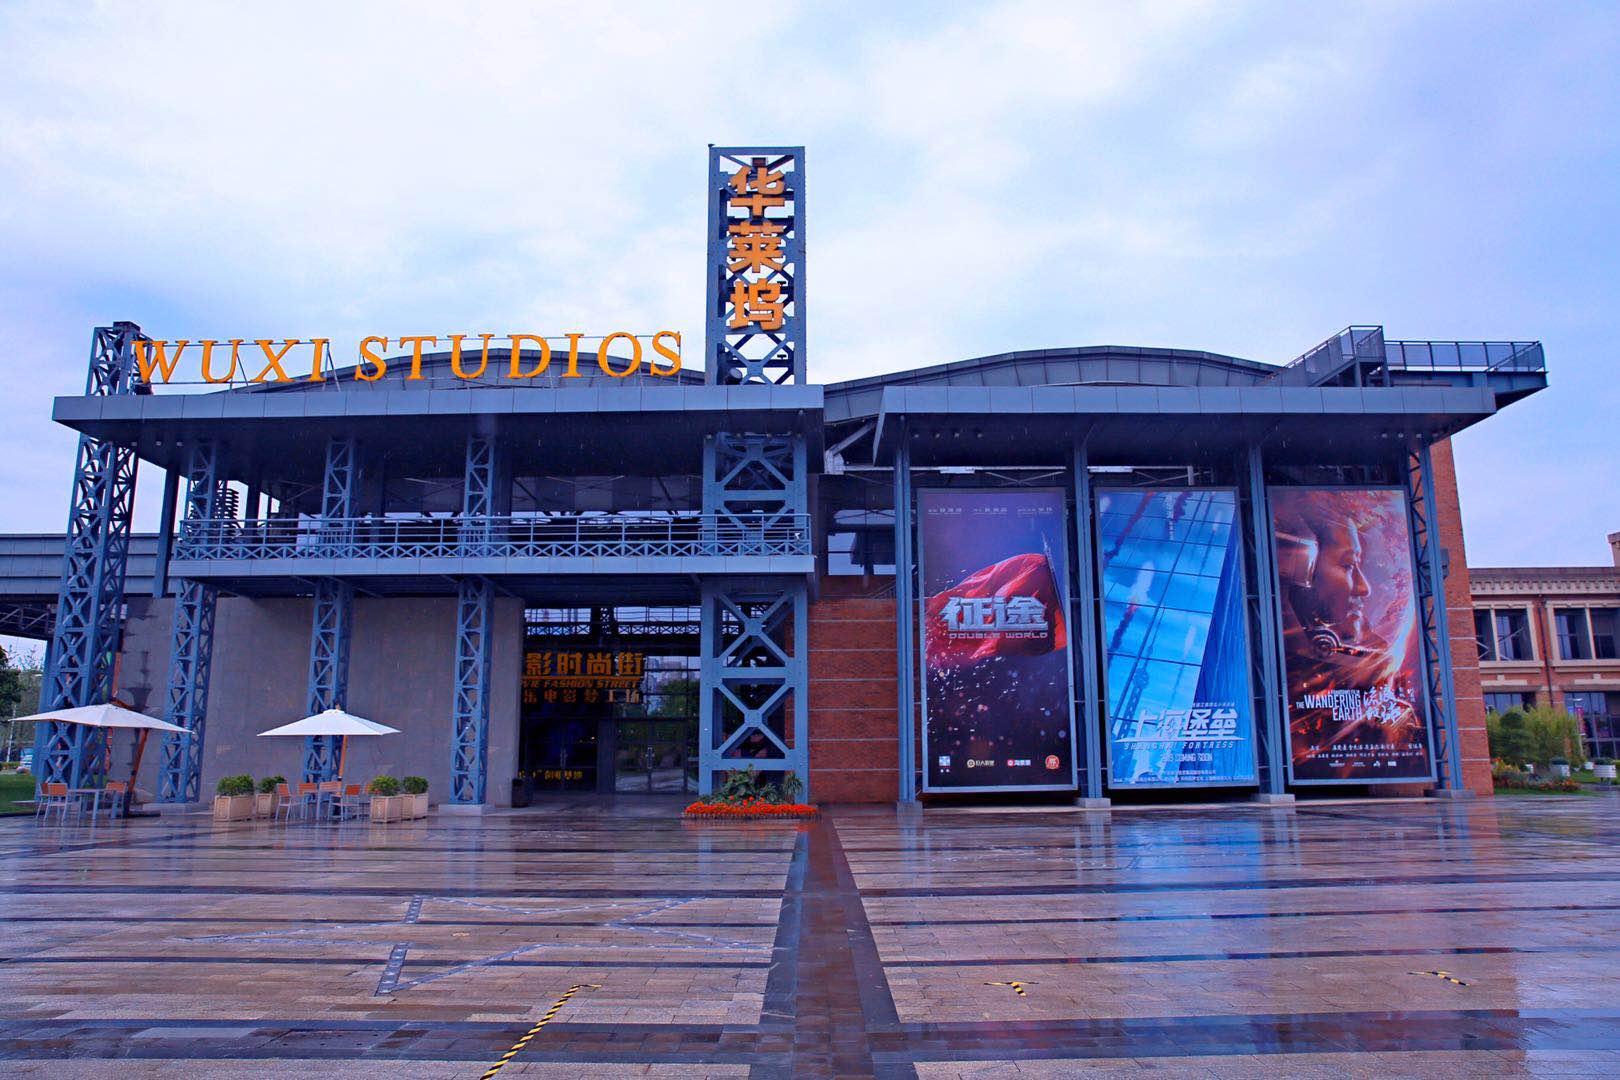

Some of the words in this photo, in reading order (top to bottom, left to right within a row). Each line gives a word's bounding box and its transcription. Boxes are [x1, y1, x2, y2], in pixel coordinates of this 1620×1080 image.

[729, 166, 786, 331] 华莱坞
[131, 338, 328, 384] WUXI
[354, 330, 682, 382] STUDIOS
[1005, 631, 1048, 639] WORLD
[526, 652, 642, 675] 影时尚街
[597, 679, 638, 688] STREET
[1304, 694, 1361, 709] WANDERING
[1332, 707, 1363, 721] EARTH
[1134, 708, 1238, 739] 上海堡垒
[1182, 741, 1234, 749] FORTRESS
[1175, 752, 1197, 762] COMING
